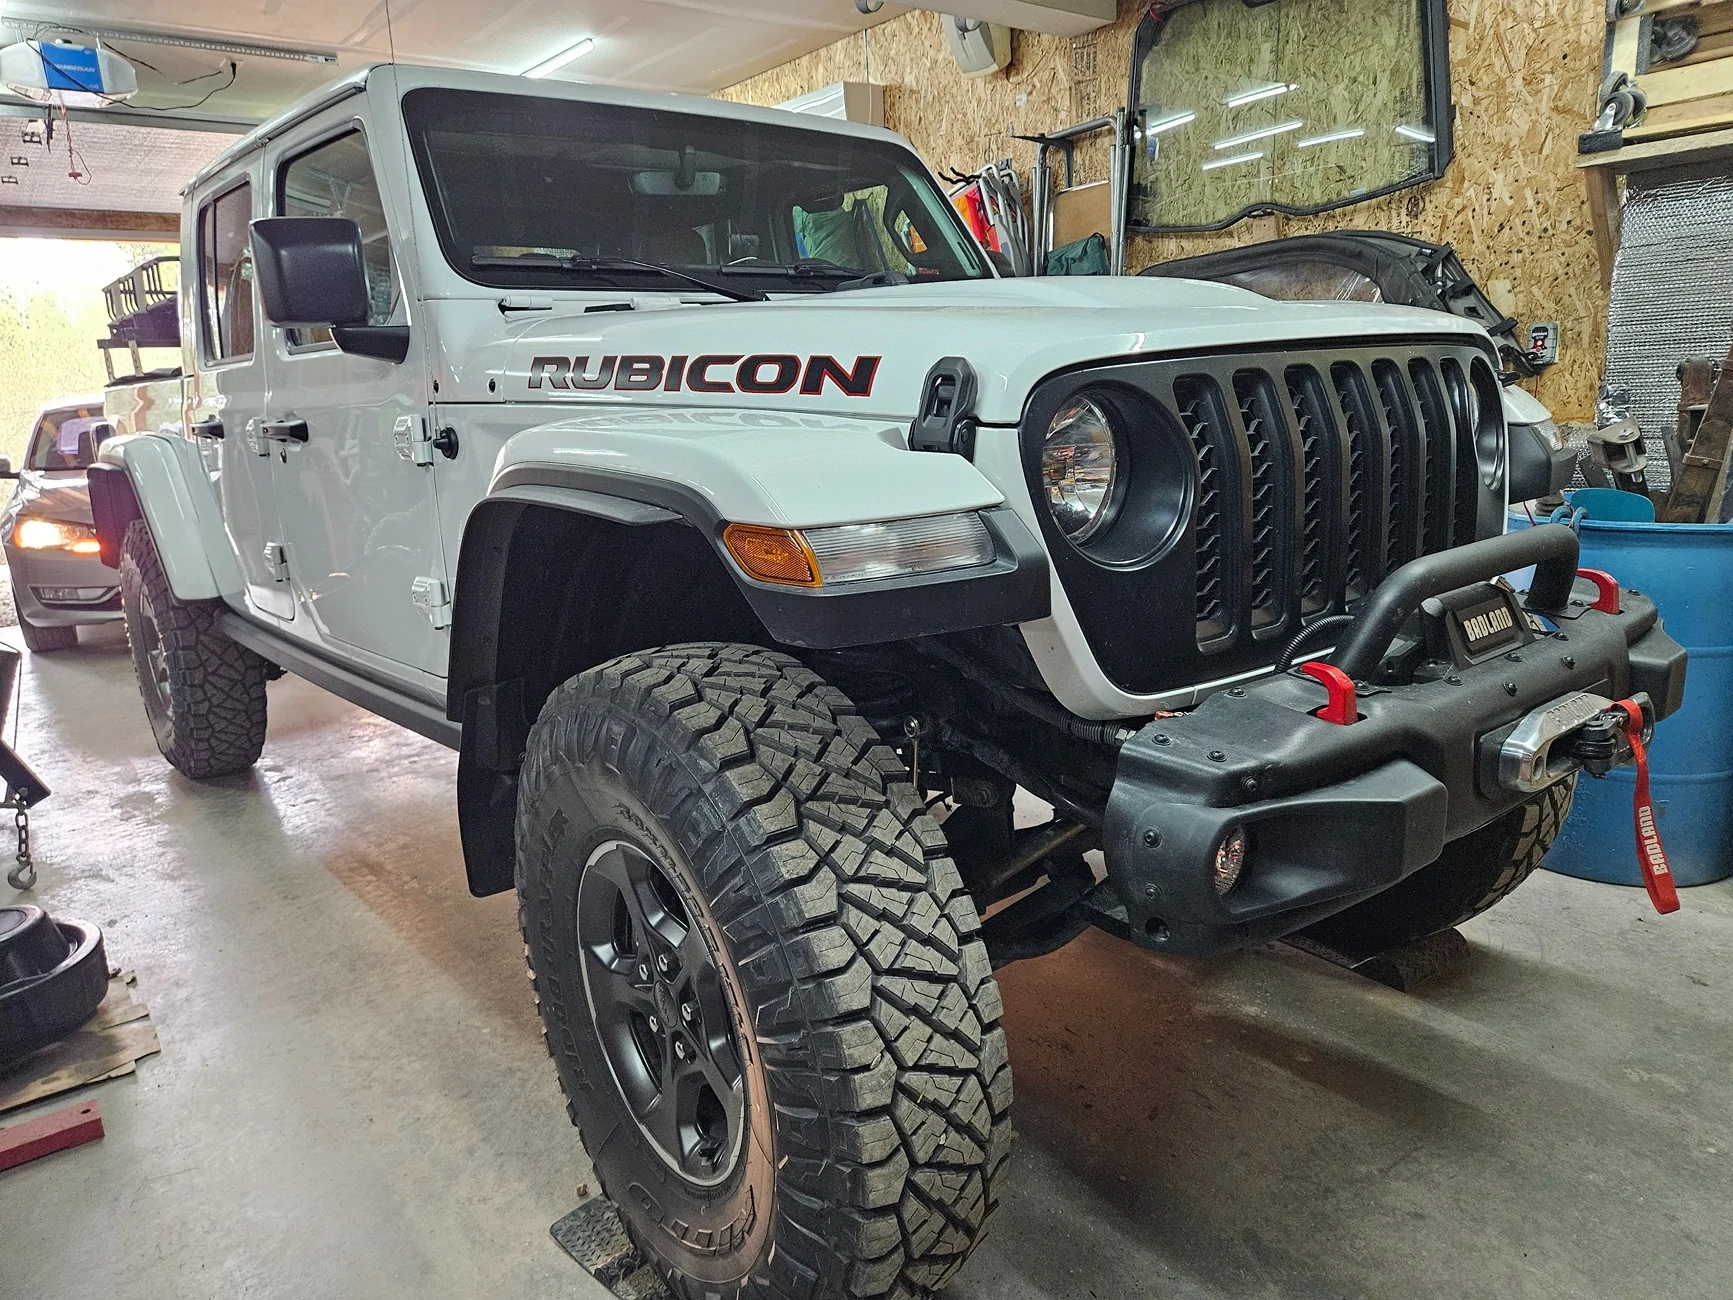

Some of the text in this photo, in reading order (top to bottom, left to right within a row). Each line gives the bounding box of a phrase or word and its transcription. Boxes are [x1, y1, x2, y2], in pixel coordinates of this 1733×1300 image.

[52, 63, 96, 74] HAMBERLAIN
[528, 354, 882, 397] RUBICON
[1463, 606, 1513, 642] BADLAND
[1546, 694, 1595, 731] BADLAND
[1638, 805, 1669, 876] BADLAND
